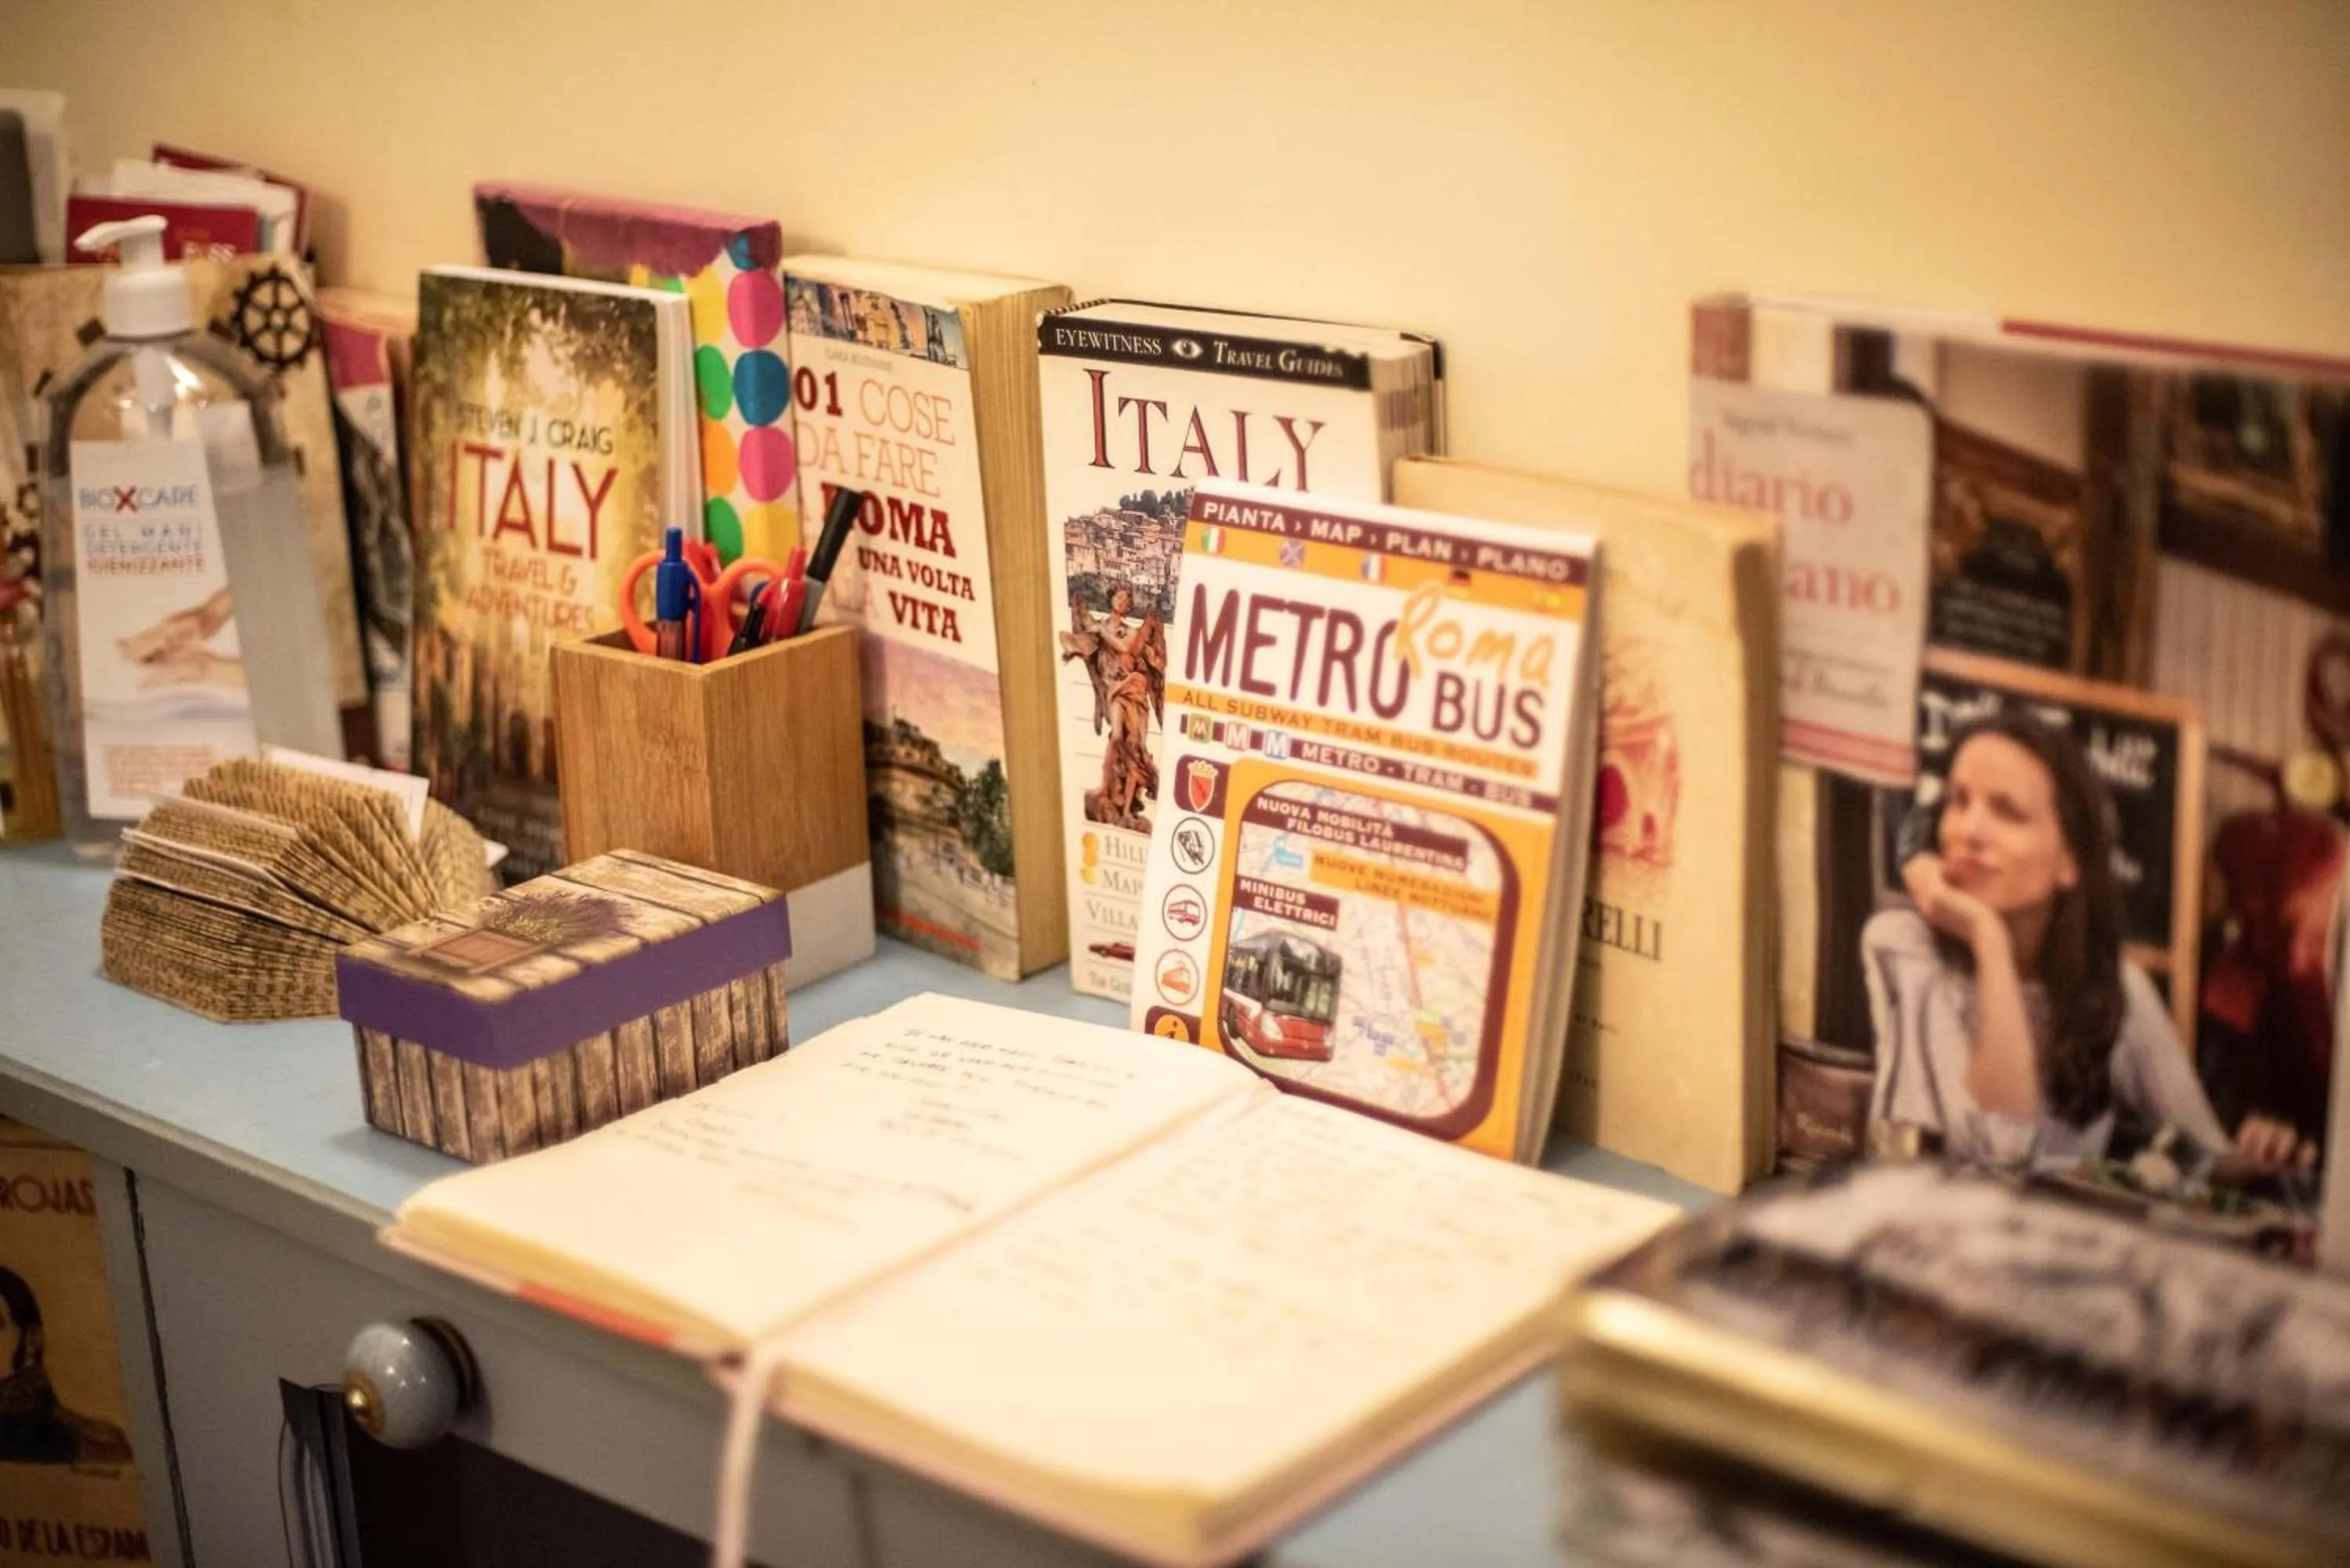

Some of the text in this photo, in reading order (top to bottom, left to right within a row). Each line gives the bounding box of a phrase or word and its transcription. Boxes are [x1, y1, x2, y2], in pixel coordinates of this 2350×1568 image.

[1055, 327, 1344, 379] EYEWITNESS TRAVEL GUIDES
[547, 417, 613, 455] CRAIG
[860, 379, 956, 446] COSE
[1083, 367, 1327, 493] ITALY
[796, 421, 941, 498] DA FARE
[1689, 431, 1854, 524] diario
[447, 438, 620, 561] ITALY
[1202, 500, 1569, 581] PIANTA MAP PLAN PLANO
[858, 545, 976, 602] UNA VOLTA
[888, 591, 963, 644] VITA
[1184, 580, 1558, 721] METRO Roma
[1182, 690, 1218, 713] ALL
[1227, 698, 1314, 730] SUBWAY
[1321, 717, 1382, 745] TRAM
[1390, 732, 1437, 755] BUS
[1432, 670, 1546, 750] BUS
[1301, 742, 1380, 774] METRO
[1401, 762, 1464, 793] TRAM
[1256, 797, 1313, 821] NUOVA
[1286, 818, 1355, 844] FILOBUS
[1240, 879, 1307, 906] MINIBUS
[1314, 854, 1367, 876] NUOVE
[1255, 896, 1338, 928] ELETTRICI
